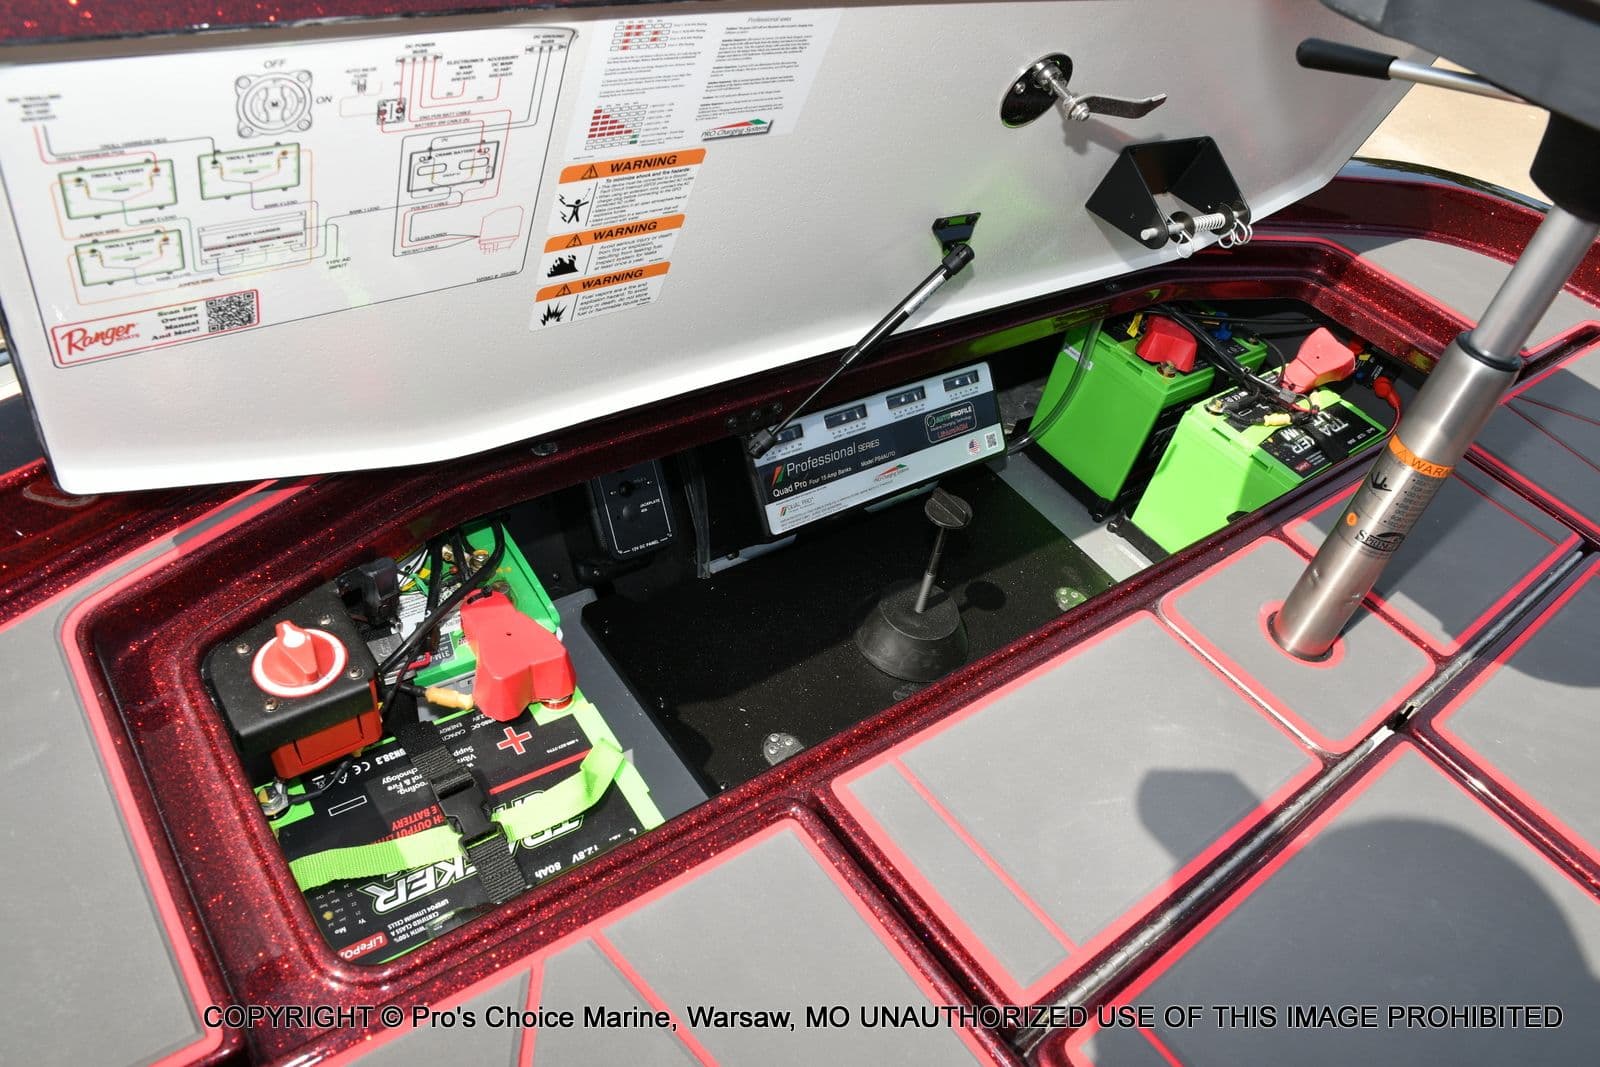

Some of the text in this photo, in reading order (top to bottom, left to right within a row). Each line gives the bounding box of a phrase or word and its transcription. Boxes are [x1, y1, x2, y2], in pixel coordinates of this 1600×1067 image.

[263, 59, 287, 69] OFF
[315, 96, 332, 105] ON
[610, 155, 677, 173] WARNING
[593, 221, 658, 240] WARNING
[582, 269, 644, 289] WARNING
[157, 308, 180, 317] Scan
[161, 312, 199, 324] Owners
[165, 319, 200, 331] Manual
[61, 323, 136, 356] Ranger
[151, 326, 200, 341] And More!
[786, 438, 880, 477] Professional SERIES
[772, 486, 793, 498] Quad
[794, 480, 808, 491] Pro
[386, 782, 403, 792] Fire
[391, 807, 427, 832] BATTERY
[534, 861, 562, 879] 80Ah
[387, 917, 405, 930] CELLS
[416, 911, 440, 926] CERTIFIED
[334, 926, 347, 935] Mo
[396, 920, 417, 933] CLASS
[393, 931, 410, 943] 100%
